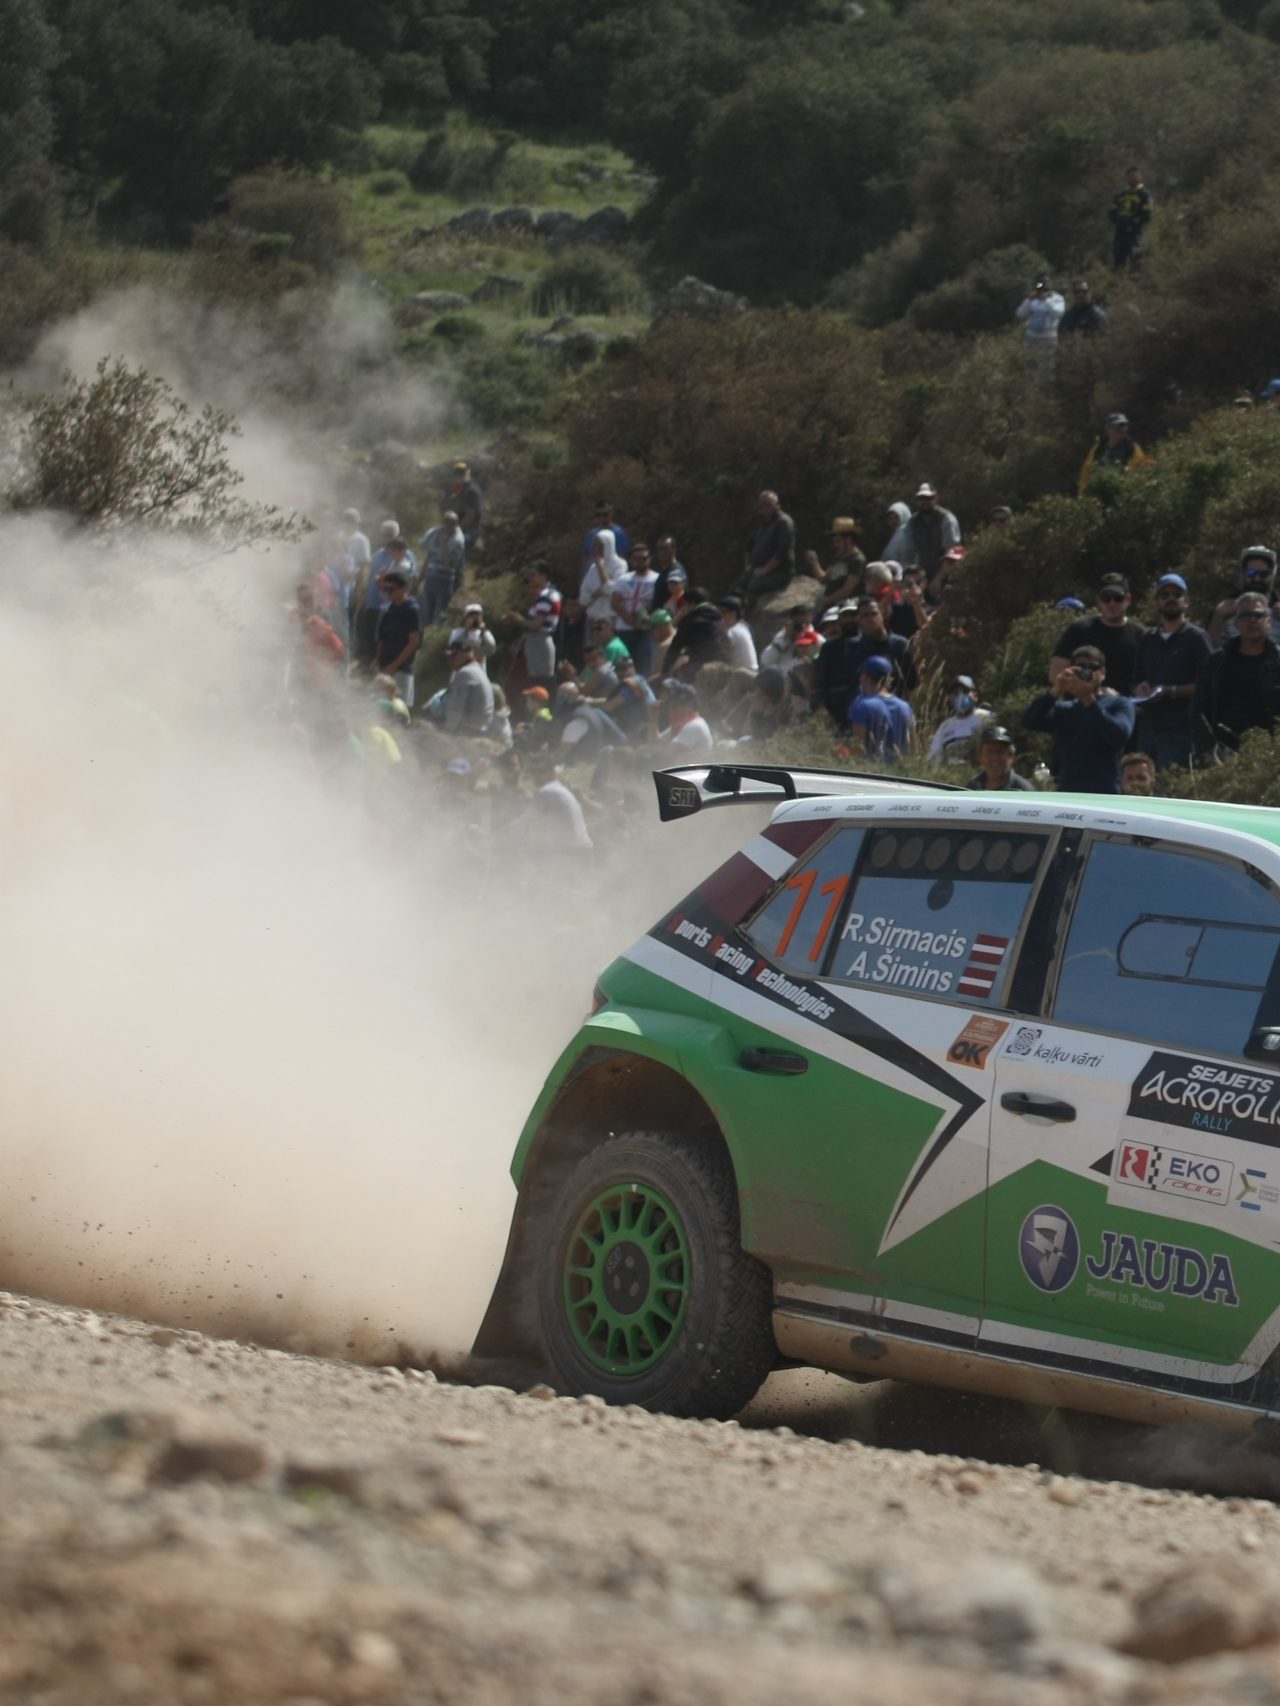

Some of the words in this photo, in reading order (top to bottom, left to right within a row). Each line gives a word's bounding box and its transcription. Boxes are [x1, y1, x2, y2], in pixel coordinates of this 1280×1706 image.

[774, 869, 850, 964] 11
[841, 913, 968, 958] R.Sirmacis
[667, 913, 712, 948] Sports
[709, 935, 755, 976] Racing
[752, 959, 836, 1021] Technologies
[846, 947, 954, 993] A.Šimins
[951, 1040, 989, 1066] OK
[1071, 1052, 1105, 1068] vārti
[1187, 1064, 1275, 1094] SEAJETS
[1191, 1112, 1233, 1132] RALLY
[1168, 1156, 1220, 1184] EKO
[1162, 1177, 1225, 1198] racing
[1086, 1231, 1239, 1307] JAUDA
